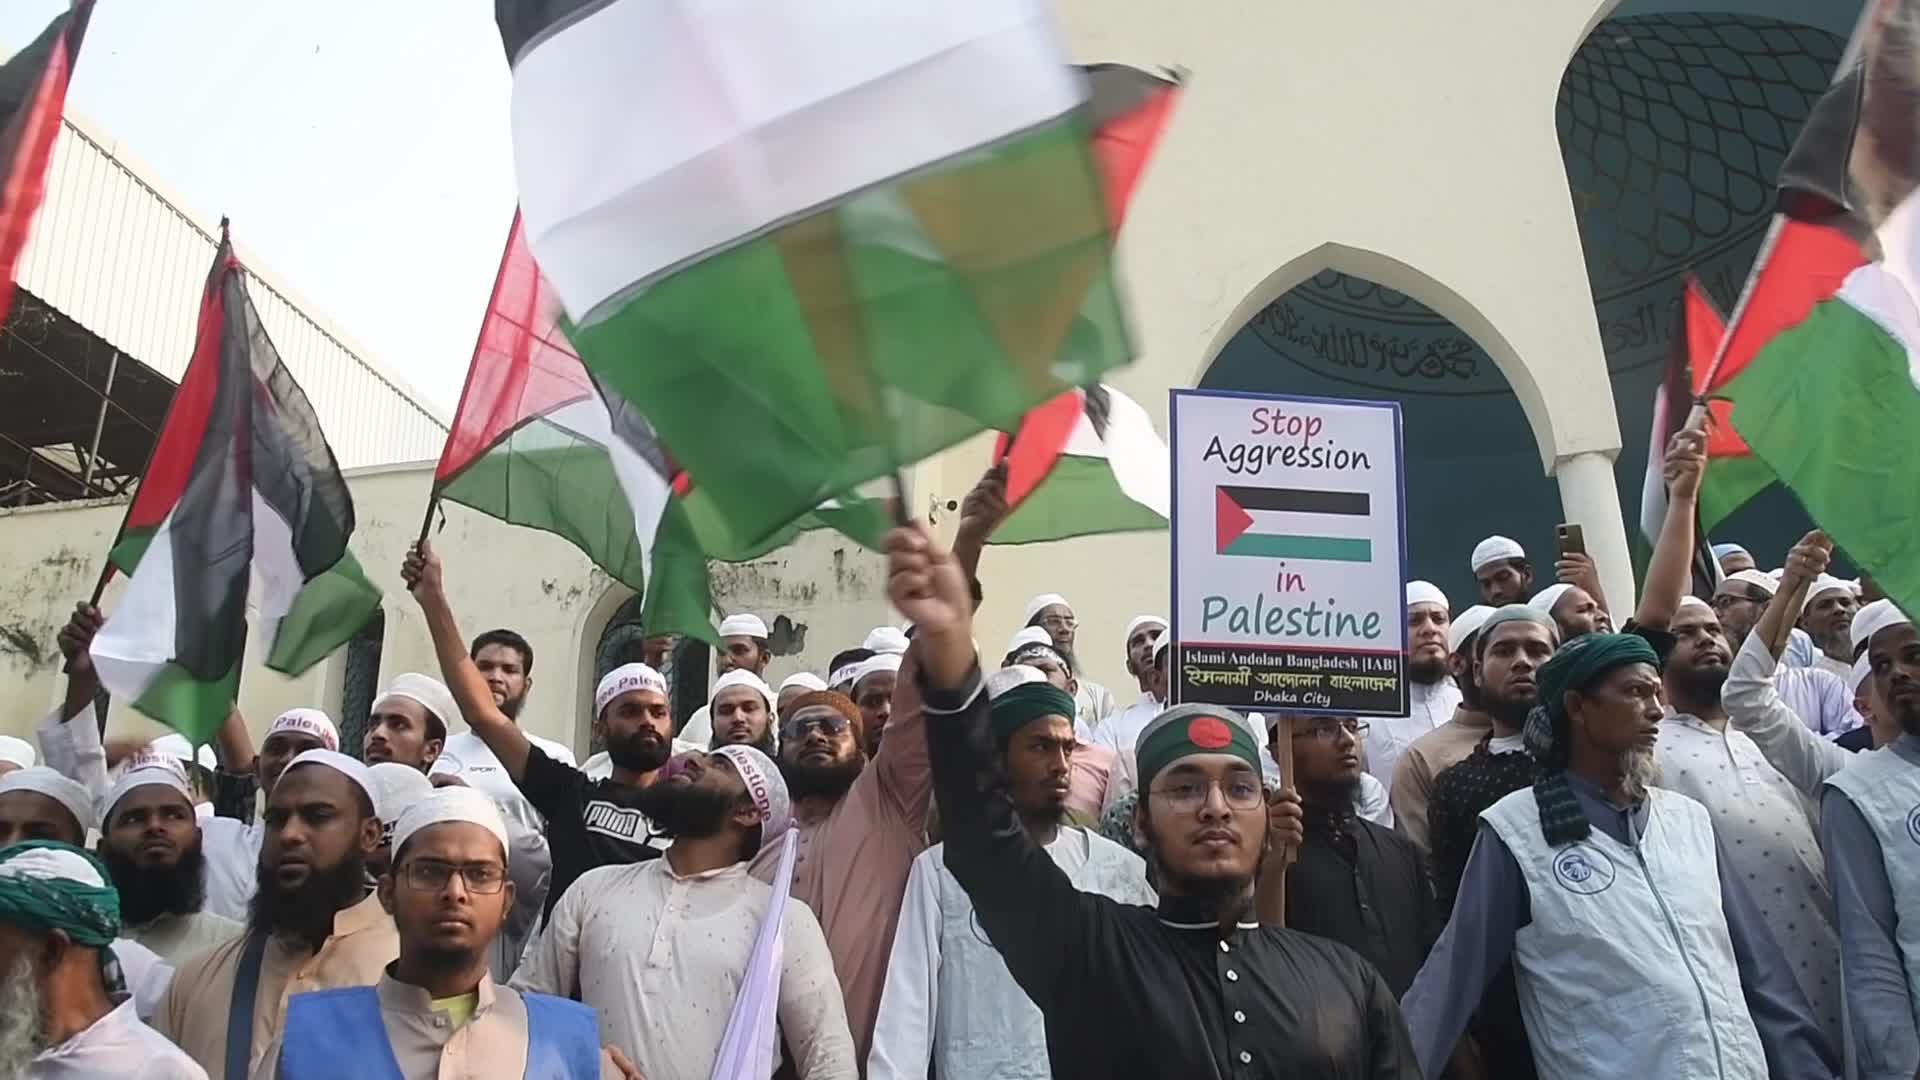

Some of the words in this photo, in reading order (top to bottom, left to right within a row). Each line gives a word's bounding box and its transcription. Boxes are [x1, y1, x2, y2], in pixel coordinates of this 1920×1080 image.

[1251, 407, 1322, 446] Stop
[1203, 435, 1371, 475] Aggression
[1276, 562, 1305, 592] in
[1202, 593, 1381, 639] Palestine
[1185, 650, 1225, 664] Islami
[1229, 652, 1282, 667] Andolan
[1287, 654, 1358, 671] Bangladesh
[1183, 665, 1251, 686] ইসলামী
[1255, 672, 1323, 688] আন্দোলন
[1329, 675, 1398, 691] বাংলাদেশ
[1254, 690, 1297, 704] Dhaka
[1302, 692, 1331, 707] City
[586, 806, 637, 836] PUMA
